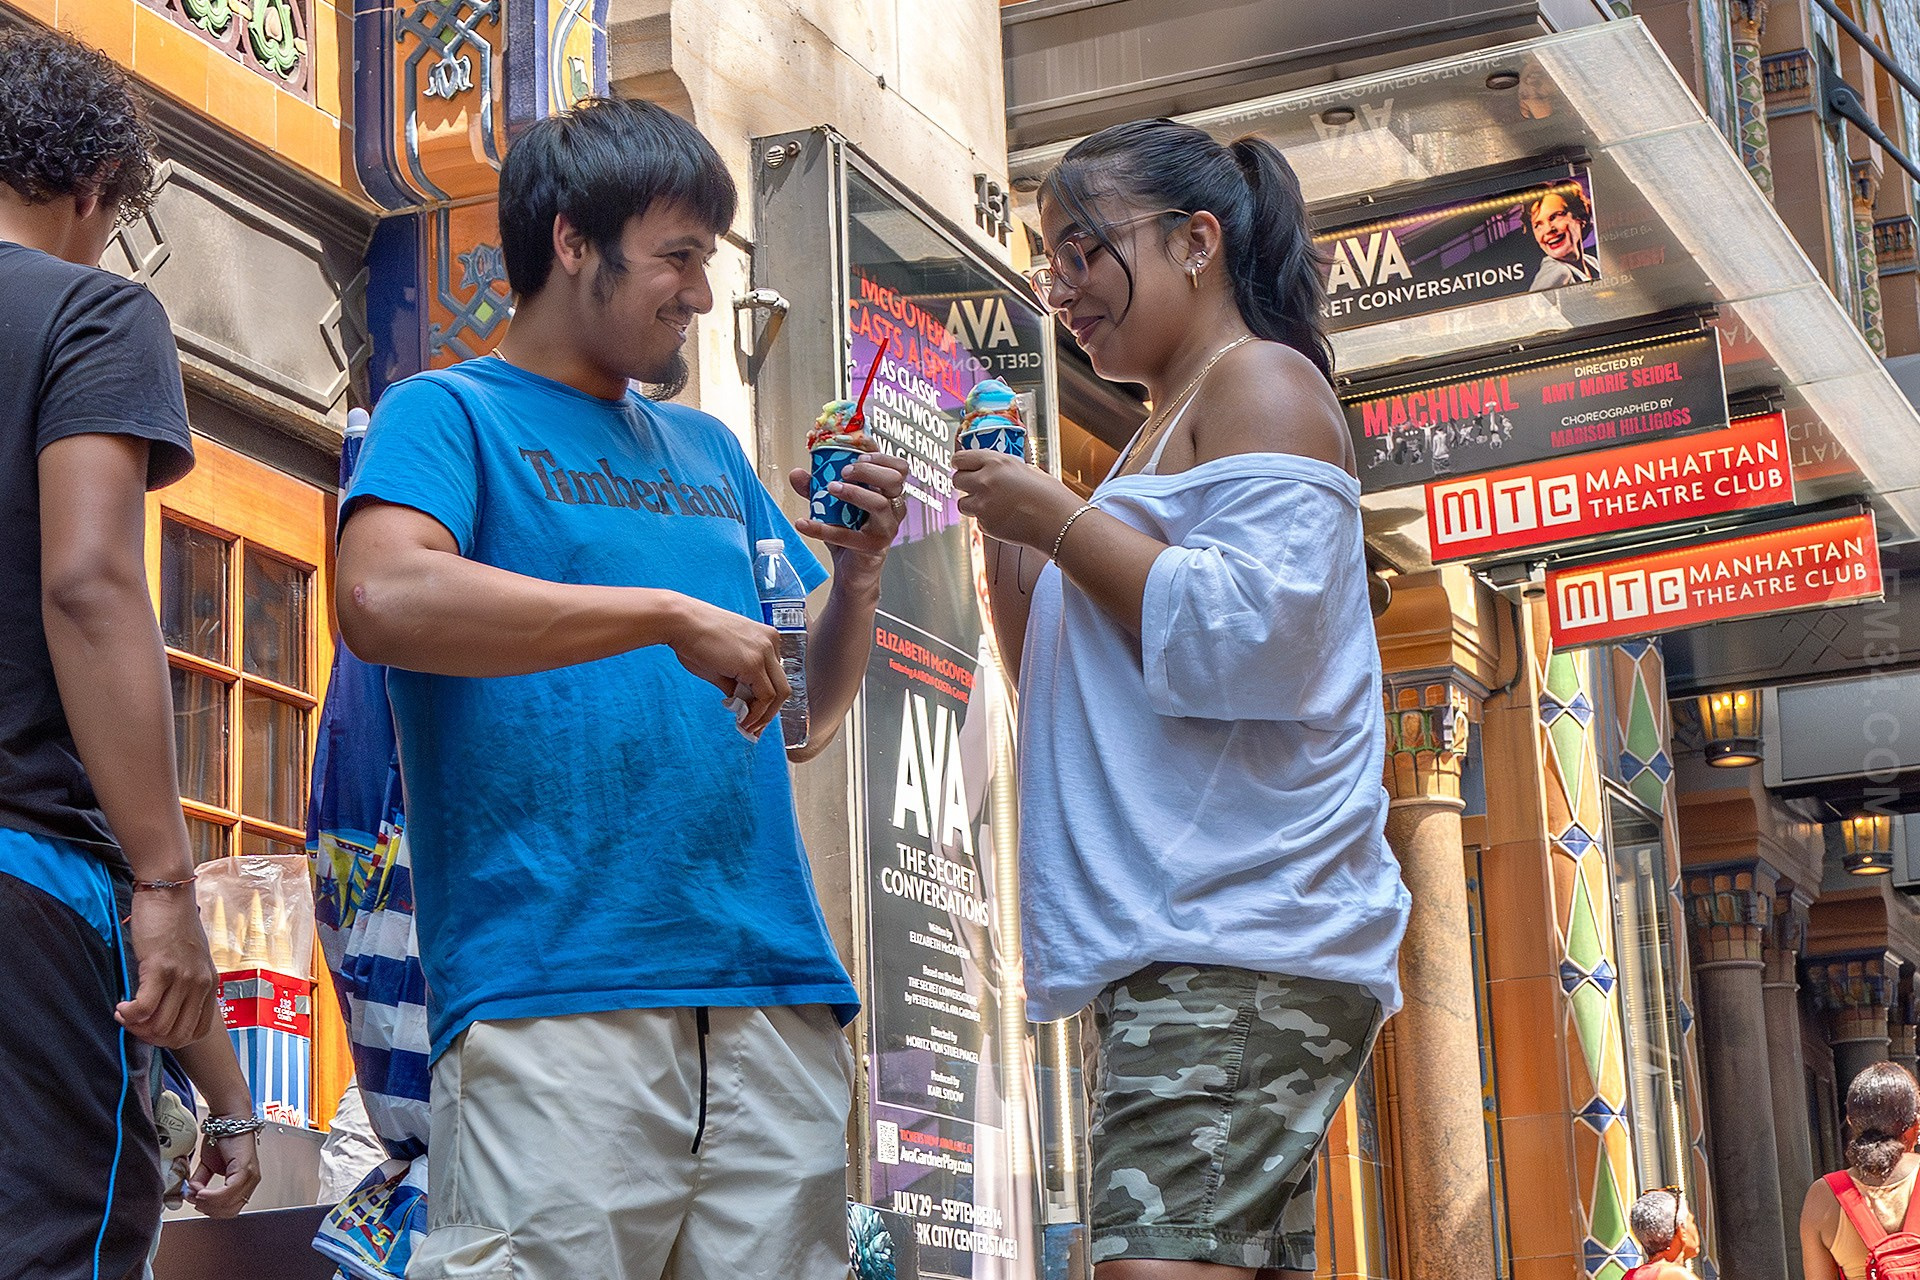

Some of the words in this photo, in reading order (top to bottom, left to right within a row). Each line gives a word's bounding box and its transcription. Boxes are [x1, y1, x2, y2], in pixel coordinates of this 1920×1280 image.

[1326, 229, 1413, 295] AVA
[1357, 263, 1524, 313] CONVERSATIONS
[850, 298, 904, 360] CASTS
[907, 337, 922, 372] A
[923, 346, 966, 405] SPELL
[1574, 358, 1618, 378] DIRECTED
[1619, 355, 1644, 369] BY
[873, 378, 949, 443] HOLLYWOOD
[880, 356, 897, 382] AS
[897, 367, 942, 412] CLASSIC
[1362, 376, 1519, 438] MACHINAL
[1542, 384, 1575, 405] AMY
[1581, 370, 1628, 399] MARIE
[1631, 361, 1682, 389] SEIDEL
[1561, 400, 1657, 427] CHOREOGRAPHED
[1658, 397, 1674, 411] BY
[873, 406, 916, 449] FEMME
[915, 431, 952, 473] FATALE
[1551, 421, 1617, 449] MADISON
[1619, 407, 1692, 437] HILLIGOSS
[518, 446, 746, 525] Timberland
[1434, 475, 1580, 544] MTC
[1585, 439, 1779, 493] MANHATTAN
[1588, 484, 1705, 518] THEATRE
[1713, 472, 1783, 498] CLUB
[1558, 568, 1687, 630] MTC
[1689, 537, 1864, 585] MANHATTAN
[1692, 576, 1796, 608] THEATRE
[1804, 563, 1868, 589] CLUB
[876, 627, 931, 667] ELIZABETH
[931, 653, 976, 690] McGOVERN
[892, 688, 974, 856] AVA
[881, 867, 989, 927] CONVERSATIONS
[896, 842, 927, 878] THE
[928, 851, 975, 894] SECRET
[893, 1191, 919, 1215] JULY
[919, 1195, 932, 1217] 29
[942, 1199, 993, 1229] SEPTEMBER
[932, 1225, 954, 1249] CITY
[954, 1229, 989, 1254] CENTER
